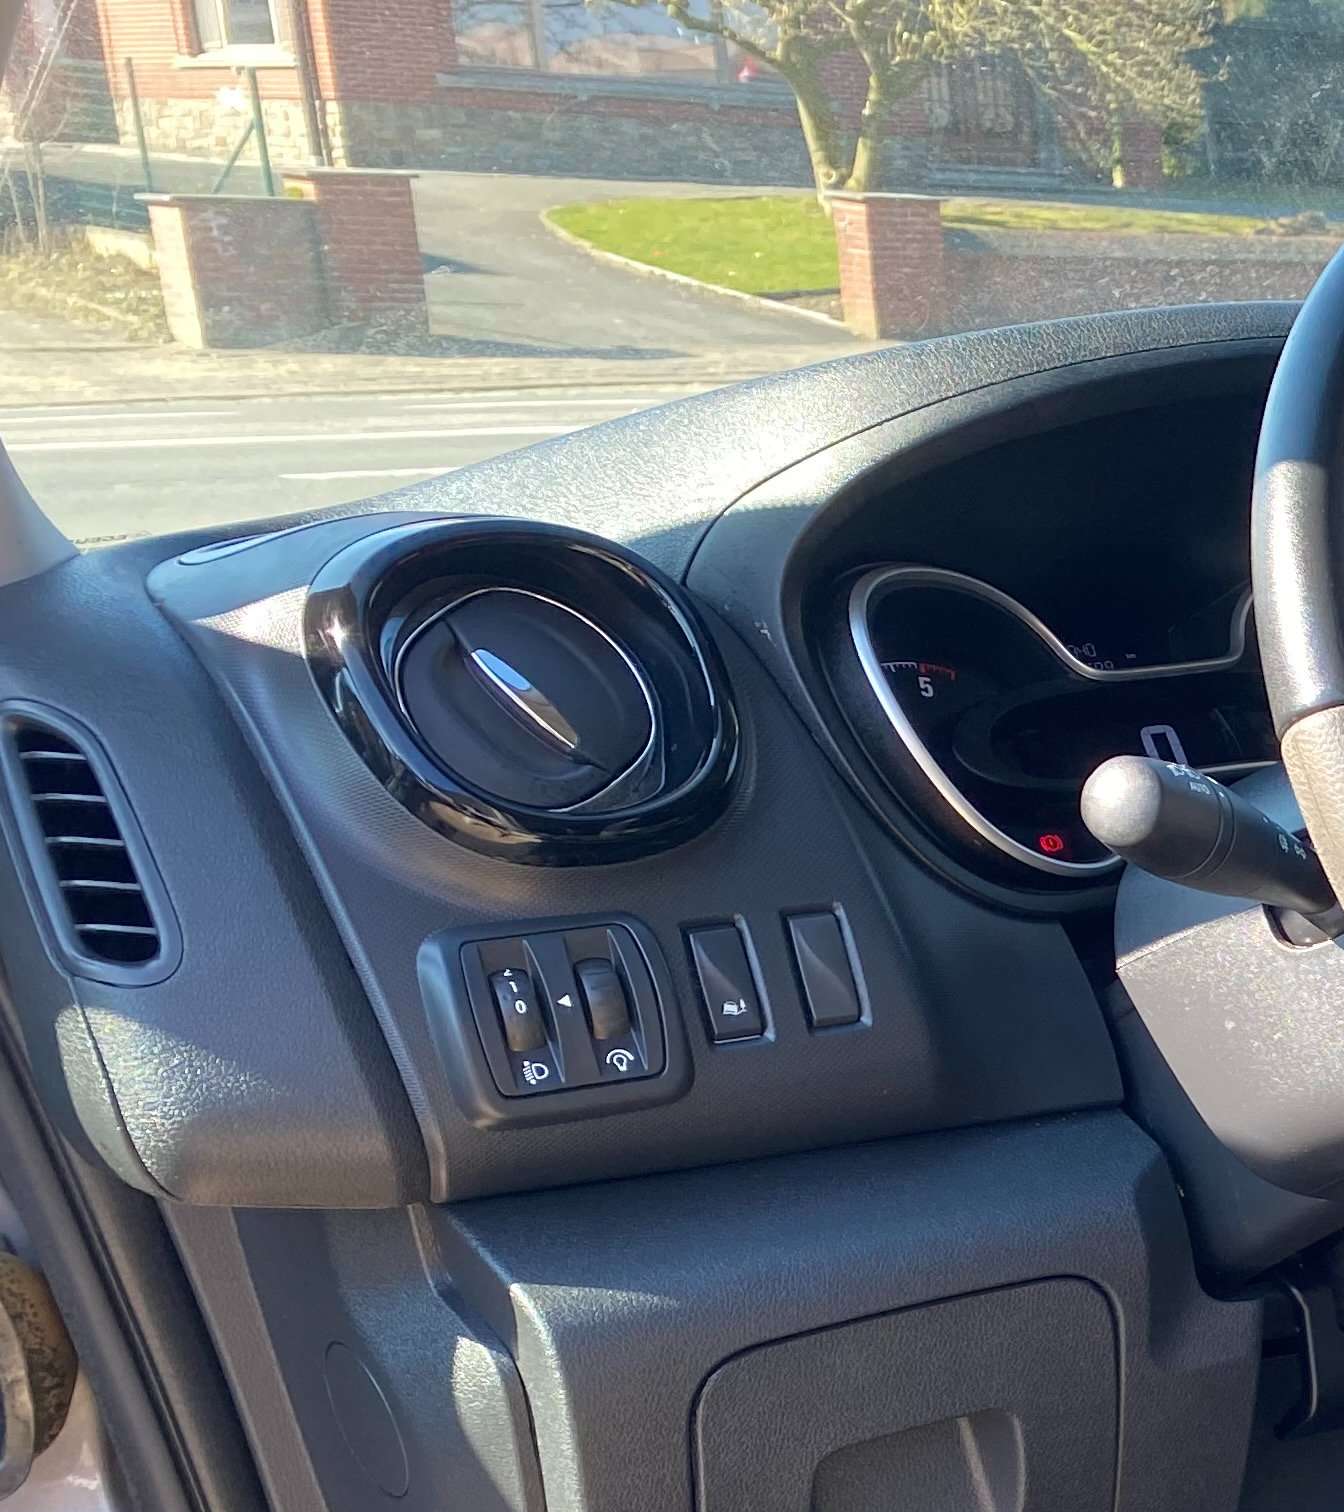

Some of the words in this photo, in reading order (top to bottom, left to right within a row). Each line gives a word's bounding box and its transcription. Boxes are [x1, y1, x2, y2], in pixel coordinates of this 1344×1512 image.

[917, 675, 934, 698] 5
[508, 980, 518, 993] 1
[514, 999, 527, 1014] 0
